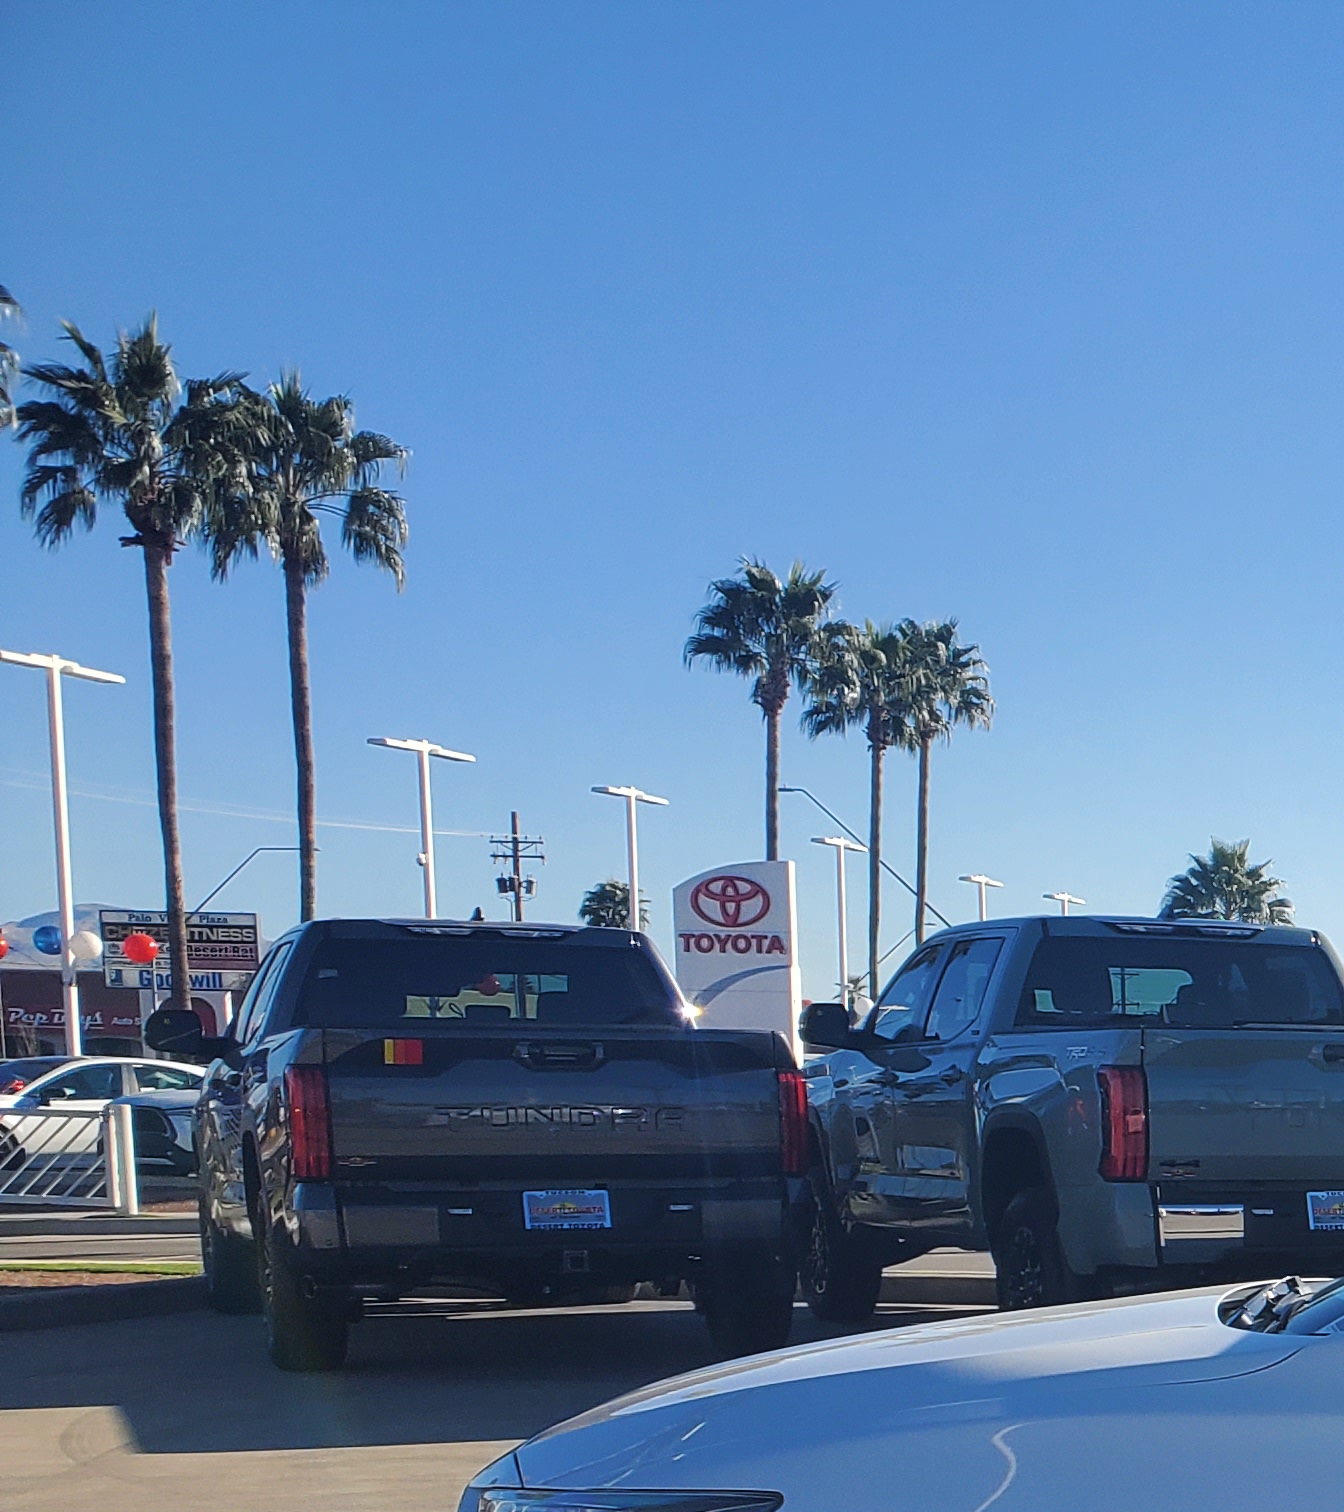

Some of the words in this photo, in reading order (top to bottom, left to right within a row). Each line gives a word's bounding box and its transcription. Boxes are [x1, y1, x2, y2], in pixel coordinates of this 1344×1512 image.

[127, 913, 152, 923] Palo
[199, 914, 228, 924] Plaza
[186, 927, 255, 942] ITNESS
[678, 932, 786, 955] TOYOTA
[187, 944, 228, 958] Desert
[139, 969, 223, 989] Goowill
[50, 1008, 104, 1030] Bys
[435, 1105, 687, 1132] TUNDRA
